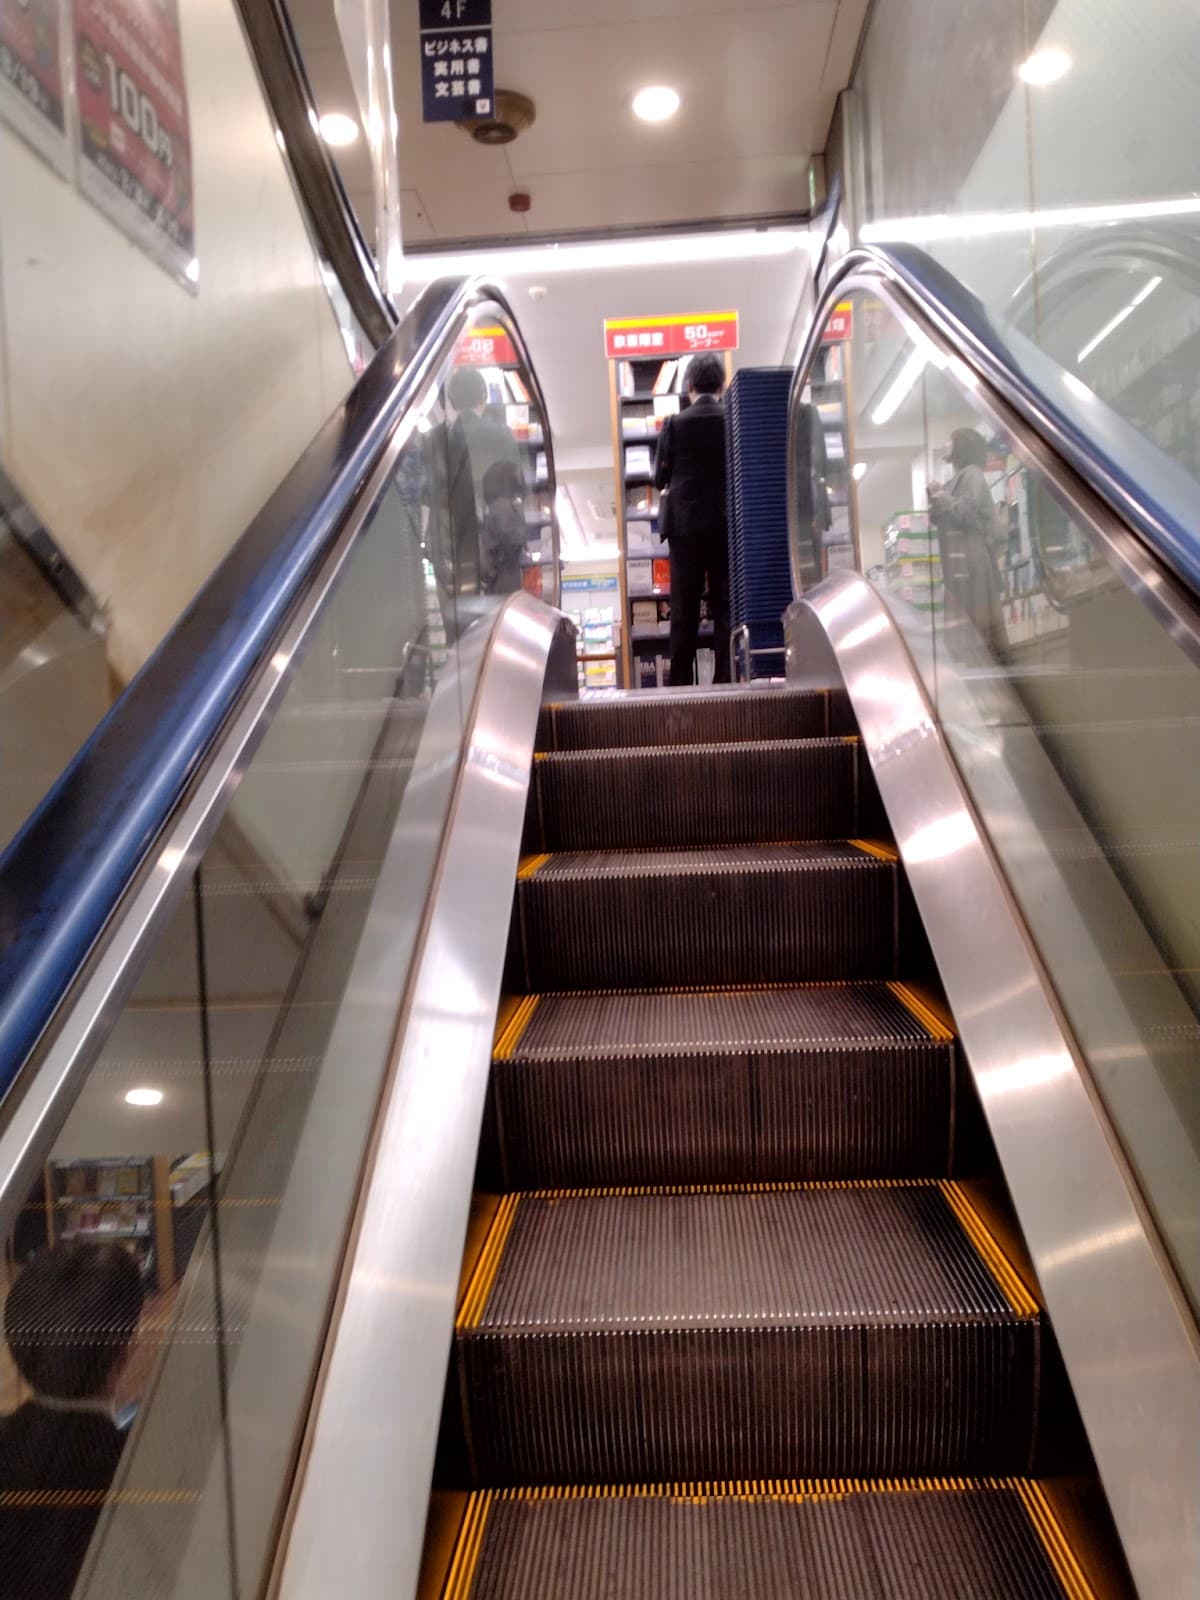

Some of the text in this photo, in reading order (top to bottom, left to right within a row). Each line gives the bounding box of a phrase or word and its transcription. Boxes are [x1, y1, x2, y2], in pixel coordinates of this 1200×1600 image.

[440, 0, 467, 19] 4F
[424, 36, 488, 56] ビジネス書
[433, 58, 480, 76] 実用書
